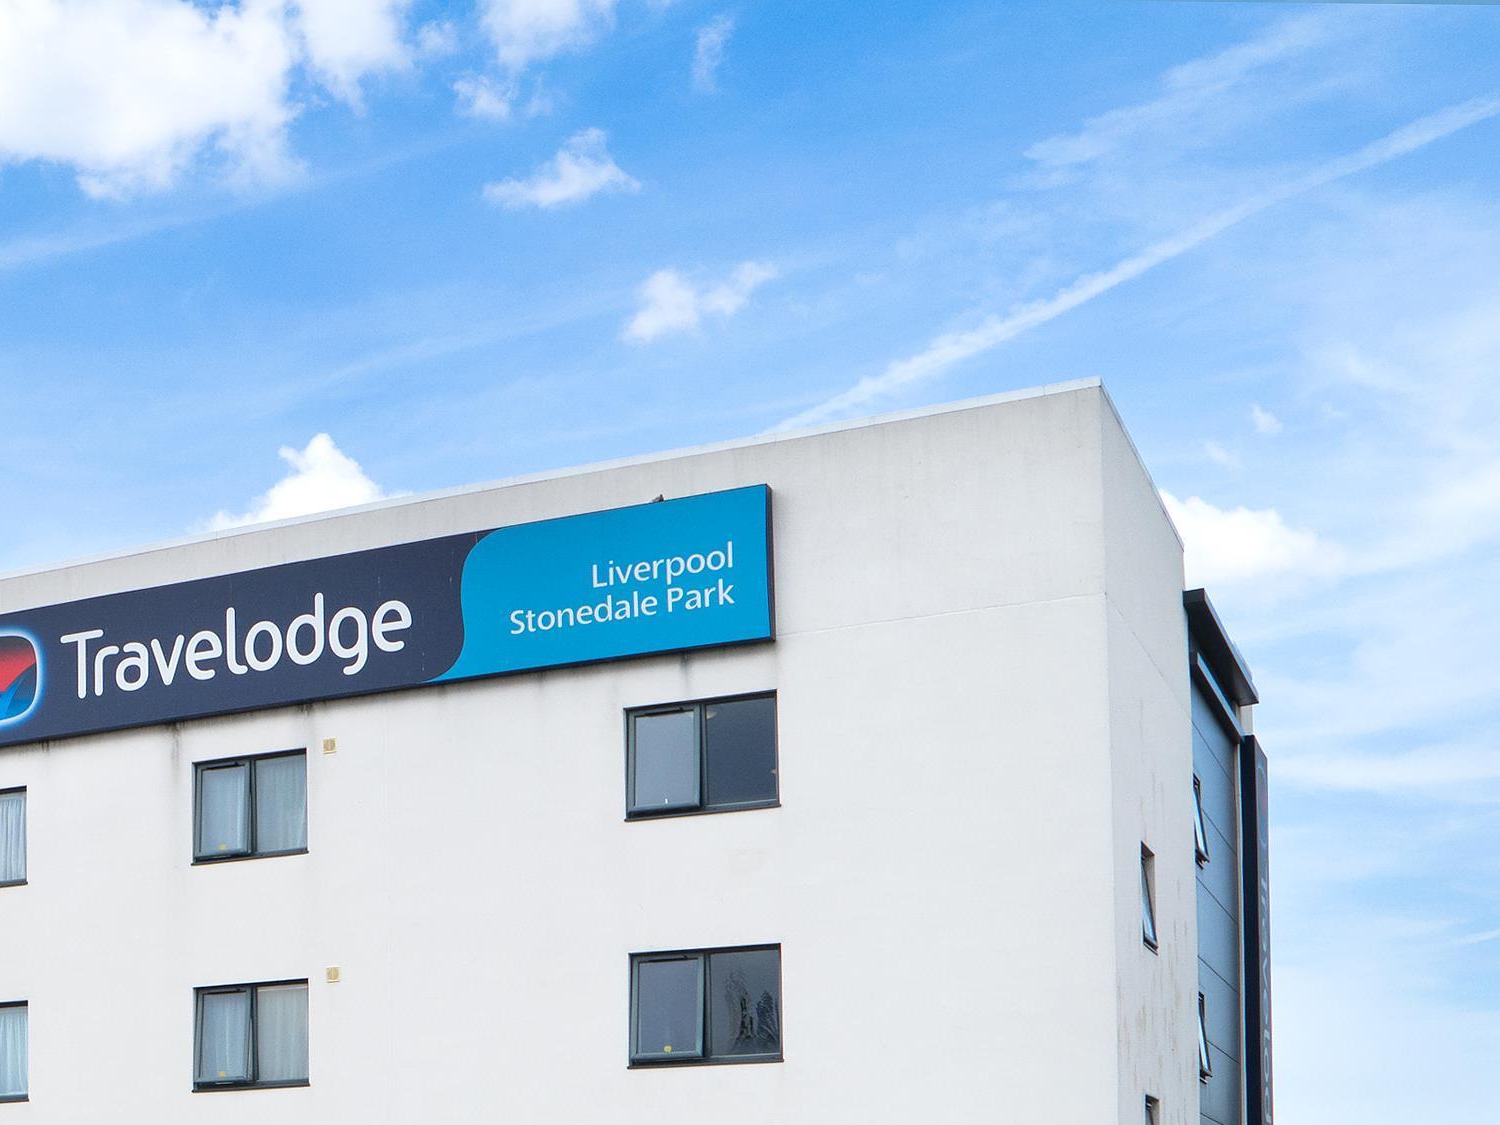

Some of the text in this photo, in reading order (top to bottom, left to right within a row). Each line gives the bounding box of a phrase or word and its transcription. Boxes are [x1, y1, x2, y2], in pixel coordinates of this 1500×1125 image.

[592, 540, 734, 588] Liverpool
[509, 578, 735, 635] Stonedale Park
[59, 592, 413, 699] Travelodge
